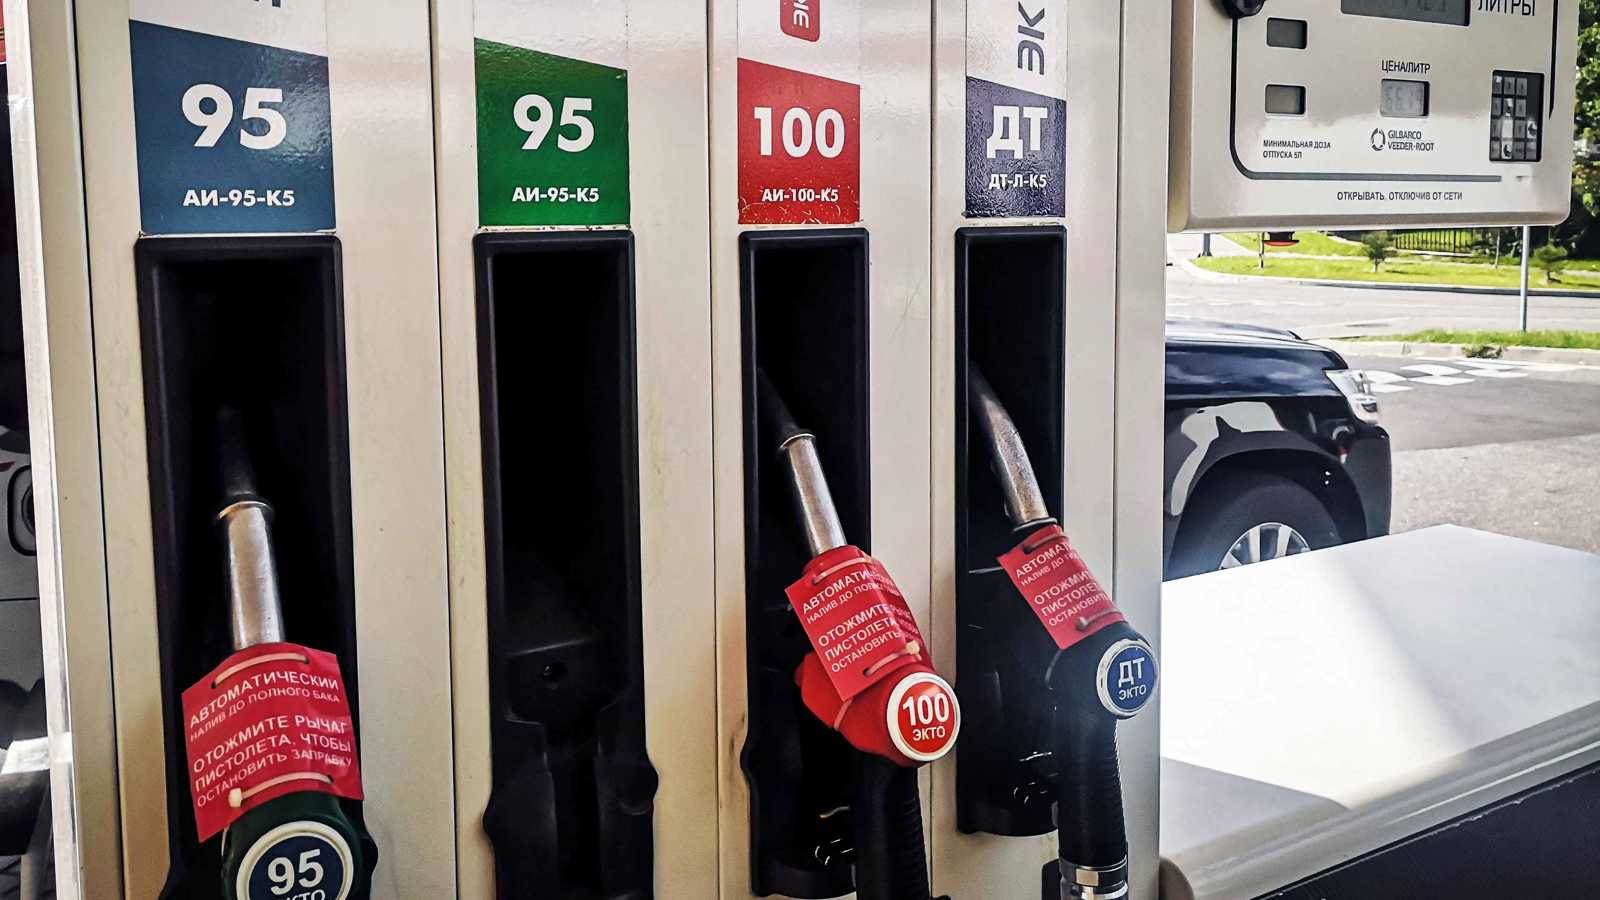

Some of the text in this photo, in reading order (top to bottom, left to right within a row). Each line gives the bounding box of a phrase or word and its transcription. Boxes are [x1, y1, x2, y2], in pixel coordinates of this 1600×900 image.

[1018, 1, 1045, 75] ЭК
[1381, 60, 1431, 74] ЦЕНА/ЛИТР
[181, 83, 287, 150] 95
[513, 94, 595, 152] 95
[753, 106, 845, 158] 100
[986, 105, 1048, 160] ДТ
[1263, 139, 1331, 149] МИНИМАЛЬНАЯ ДОЗА
[1387, 129, 1422, 140] GILBARCO
[1387, 141, 1435, 152] VEEDER-ROOT
[1262, 150, 1292, 159] ОТПУСКА
[511, 186, 600, 203] АИ-95-К5
[761, 187, 839, 203] АИ-100-К5
[988, 173, 1047, 190] ДТ-Л-К5
[1388, 191, 1430, 201] ОТКЛЮЧИВ
[1432, 191, 1442, 201] ОТ
[1443, 191, 1463, 201] СЕТИ
[182, 189, 296, 207] АИ-95-К5
[1020, 565, 1051, 586] НАЛИВ
[1050, 556, 1065, 570] ДО
[806, 599, 838, 624] НАЛИВ
[839, 590, 854, 605] ДО
[818, 603, 891, 647] ОТОЖМИТЕ
[831, 628, 902, 673] ОСТАНОВИТЬ
[1118, 657, 1145, 688] ДТ
[1118, 684, 1146, 701] ЭКТО
[190, 687, 340, 742] НАЛИВ ДО ПОЛНОГО БАКА
[902, 692, 950, 726] 100
[193, 714, 348, 774] ОТОЖМИТЕ РЫЧАГ
[300, 732, 352, 753] ЧТОБЫ
[912, 726, 946, 741] ЭКТО
[196, 748, 352, 808] ОСТАНОВИТЬ ЗАПРАВКУ
[267, 848, 324, 896] 95
